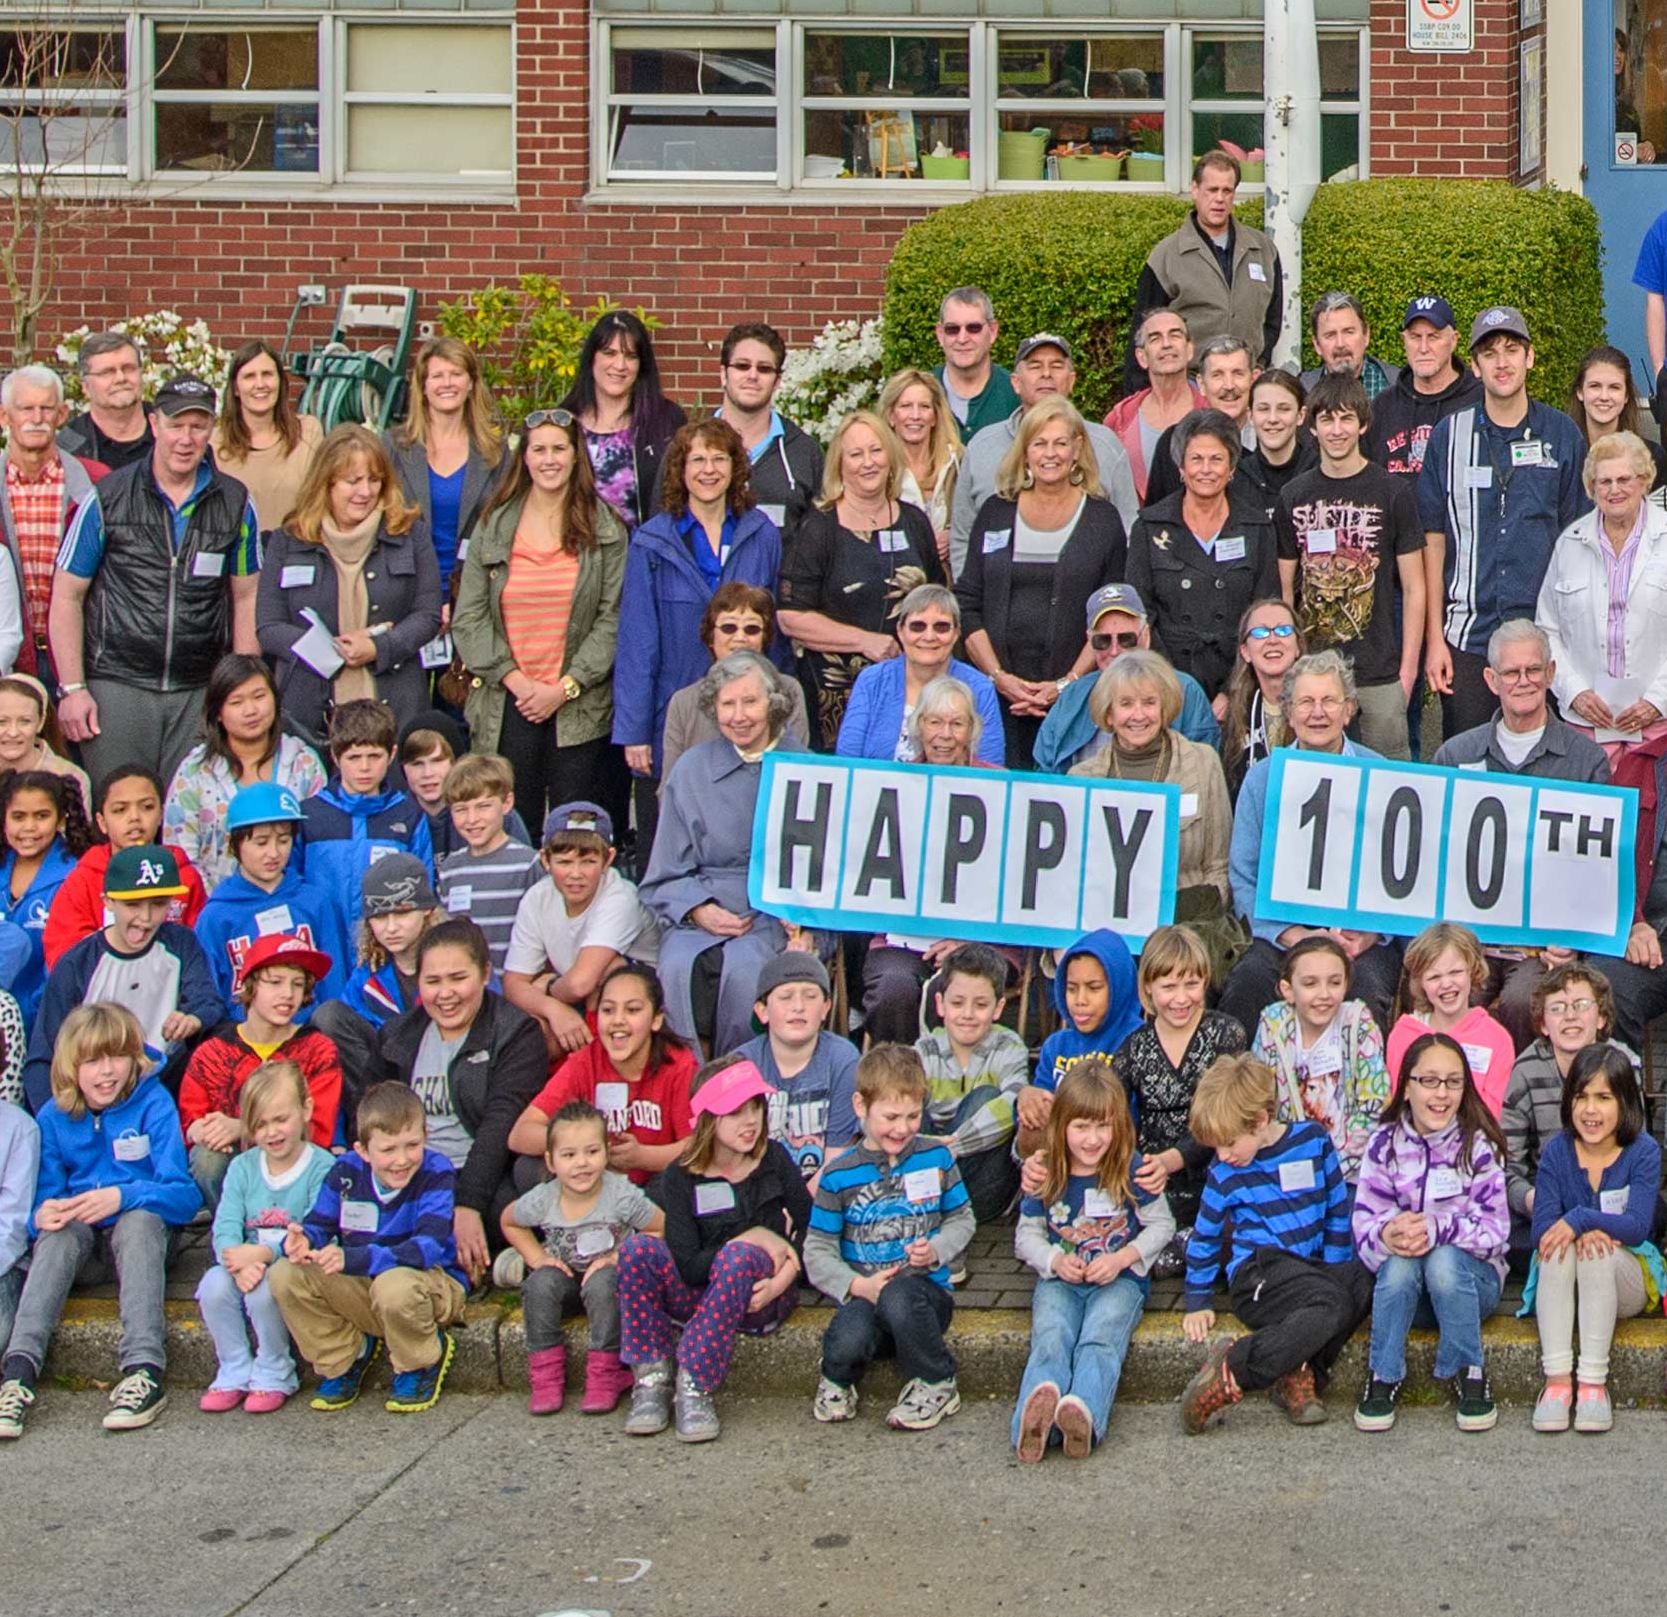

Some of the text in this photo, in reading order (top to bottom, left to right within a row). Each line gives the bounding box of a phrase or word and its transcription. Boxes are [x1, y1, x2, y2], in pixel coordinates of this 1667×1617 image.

[1412, 31, 1432, 39] HOUSE
[1415, 297, 1437, 310] W
[778, 780, 1152, 919] HAPPY
[1299, 776, 1615, 909] 100TH
[136, 858, 164, 885] A's
[847, 1182, 884, 1221] STATE
